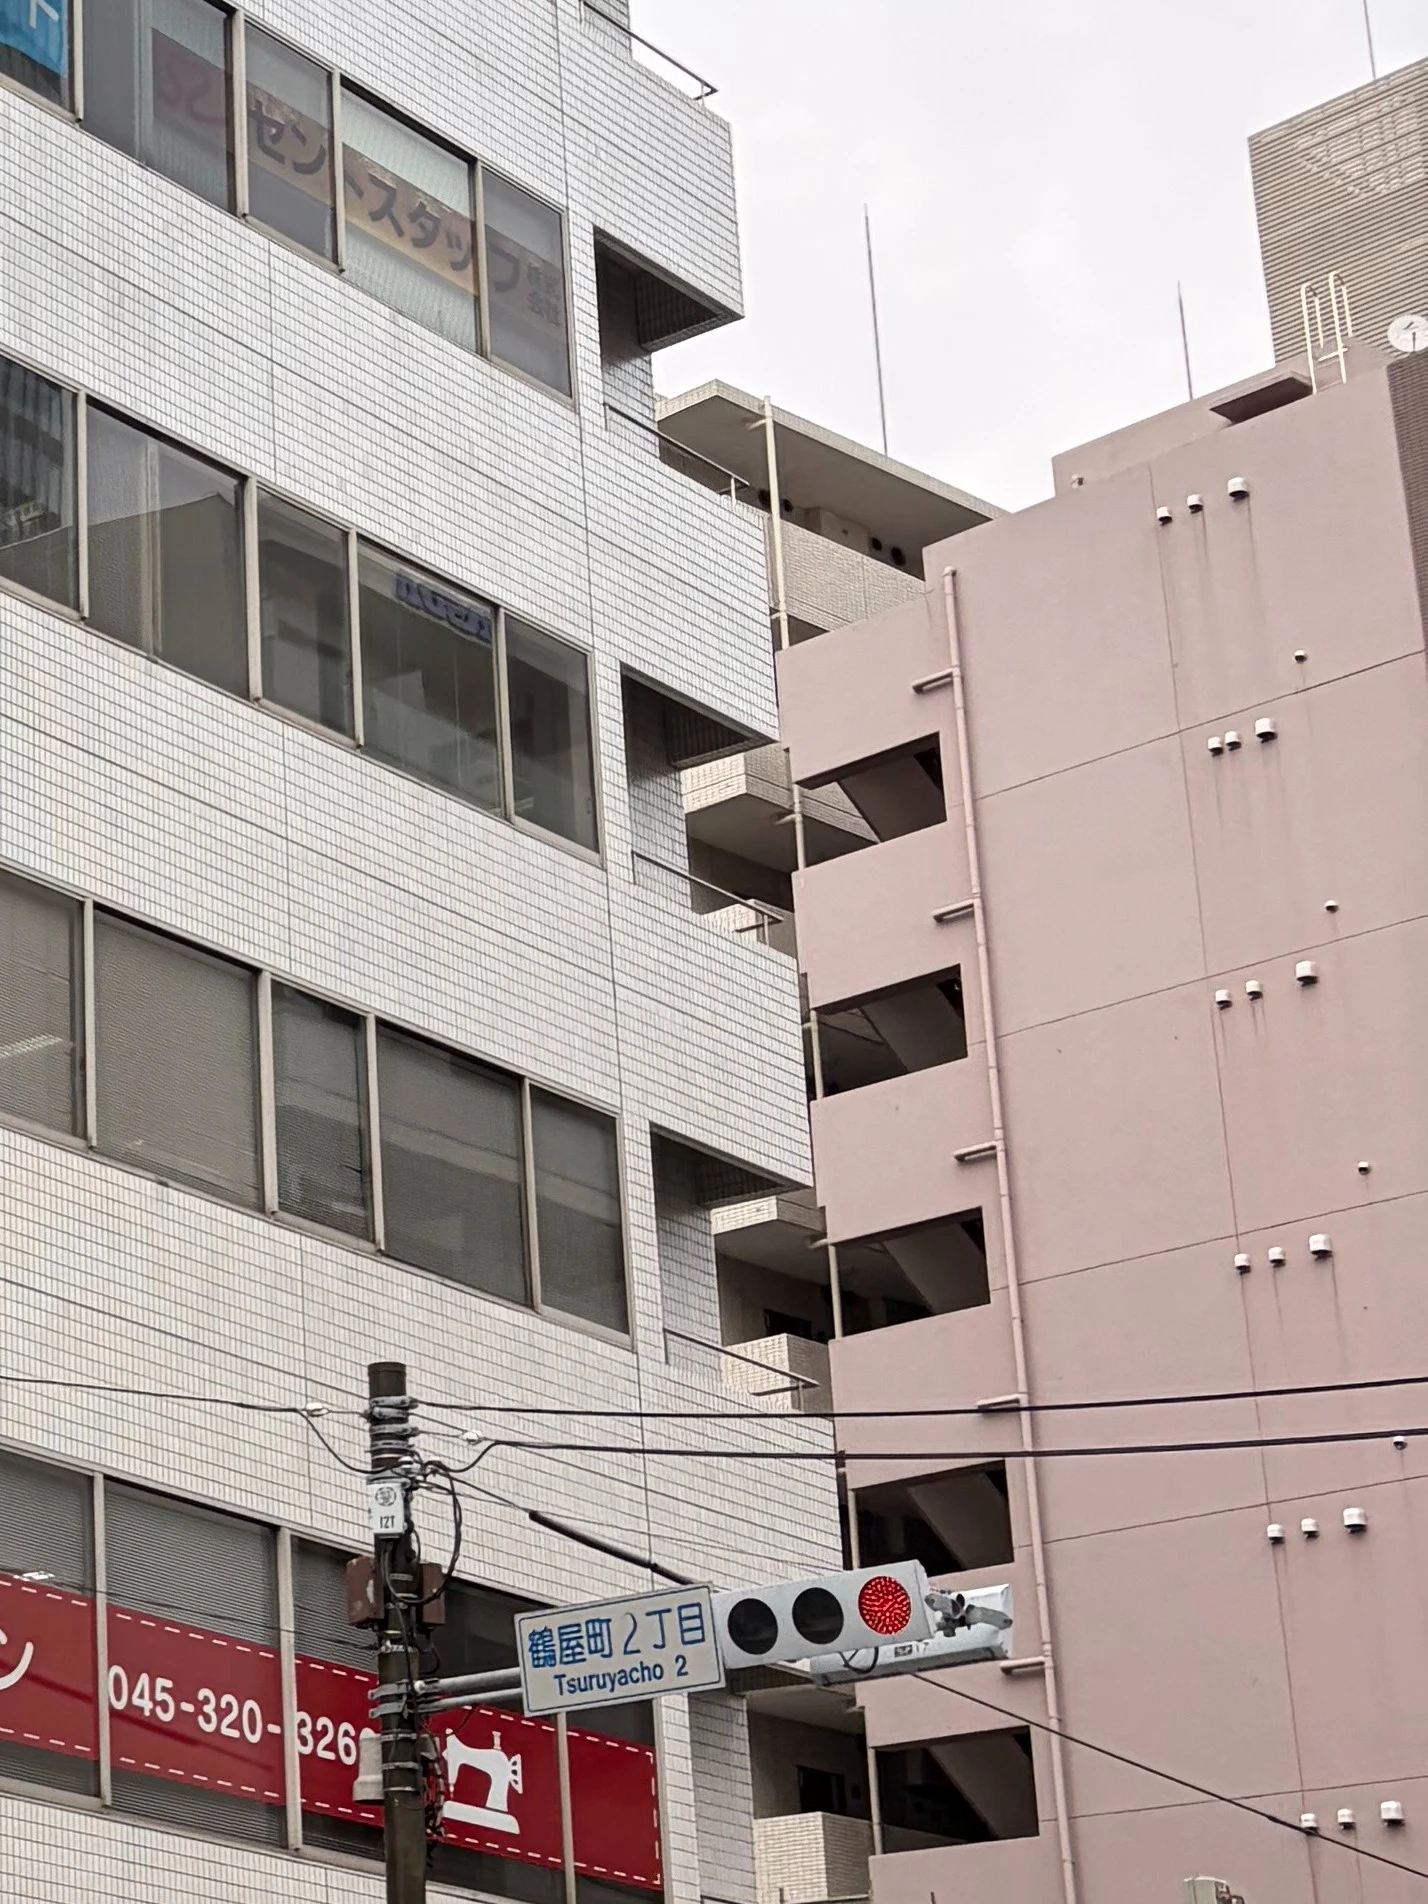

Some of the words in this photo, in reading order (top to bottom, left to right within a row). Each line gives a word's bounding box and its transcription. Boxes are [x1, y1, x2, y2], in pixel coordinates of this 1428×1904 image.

[527, 1601, 706, 1669] 鶴屋町2丁目
[553, 1660, 664, 1697] Tsuruyacho
[674, 1654, 689, 1678] 2
[107, 1664, 378, 1767] 045-320-326
